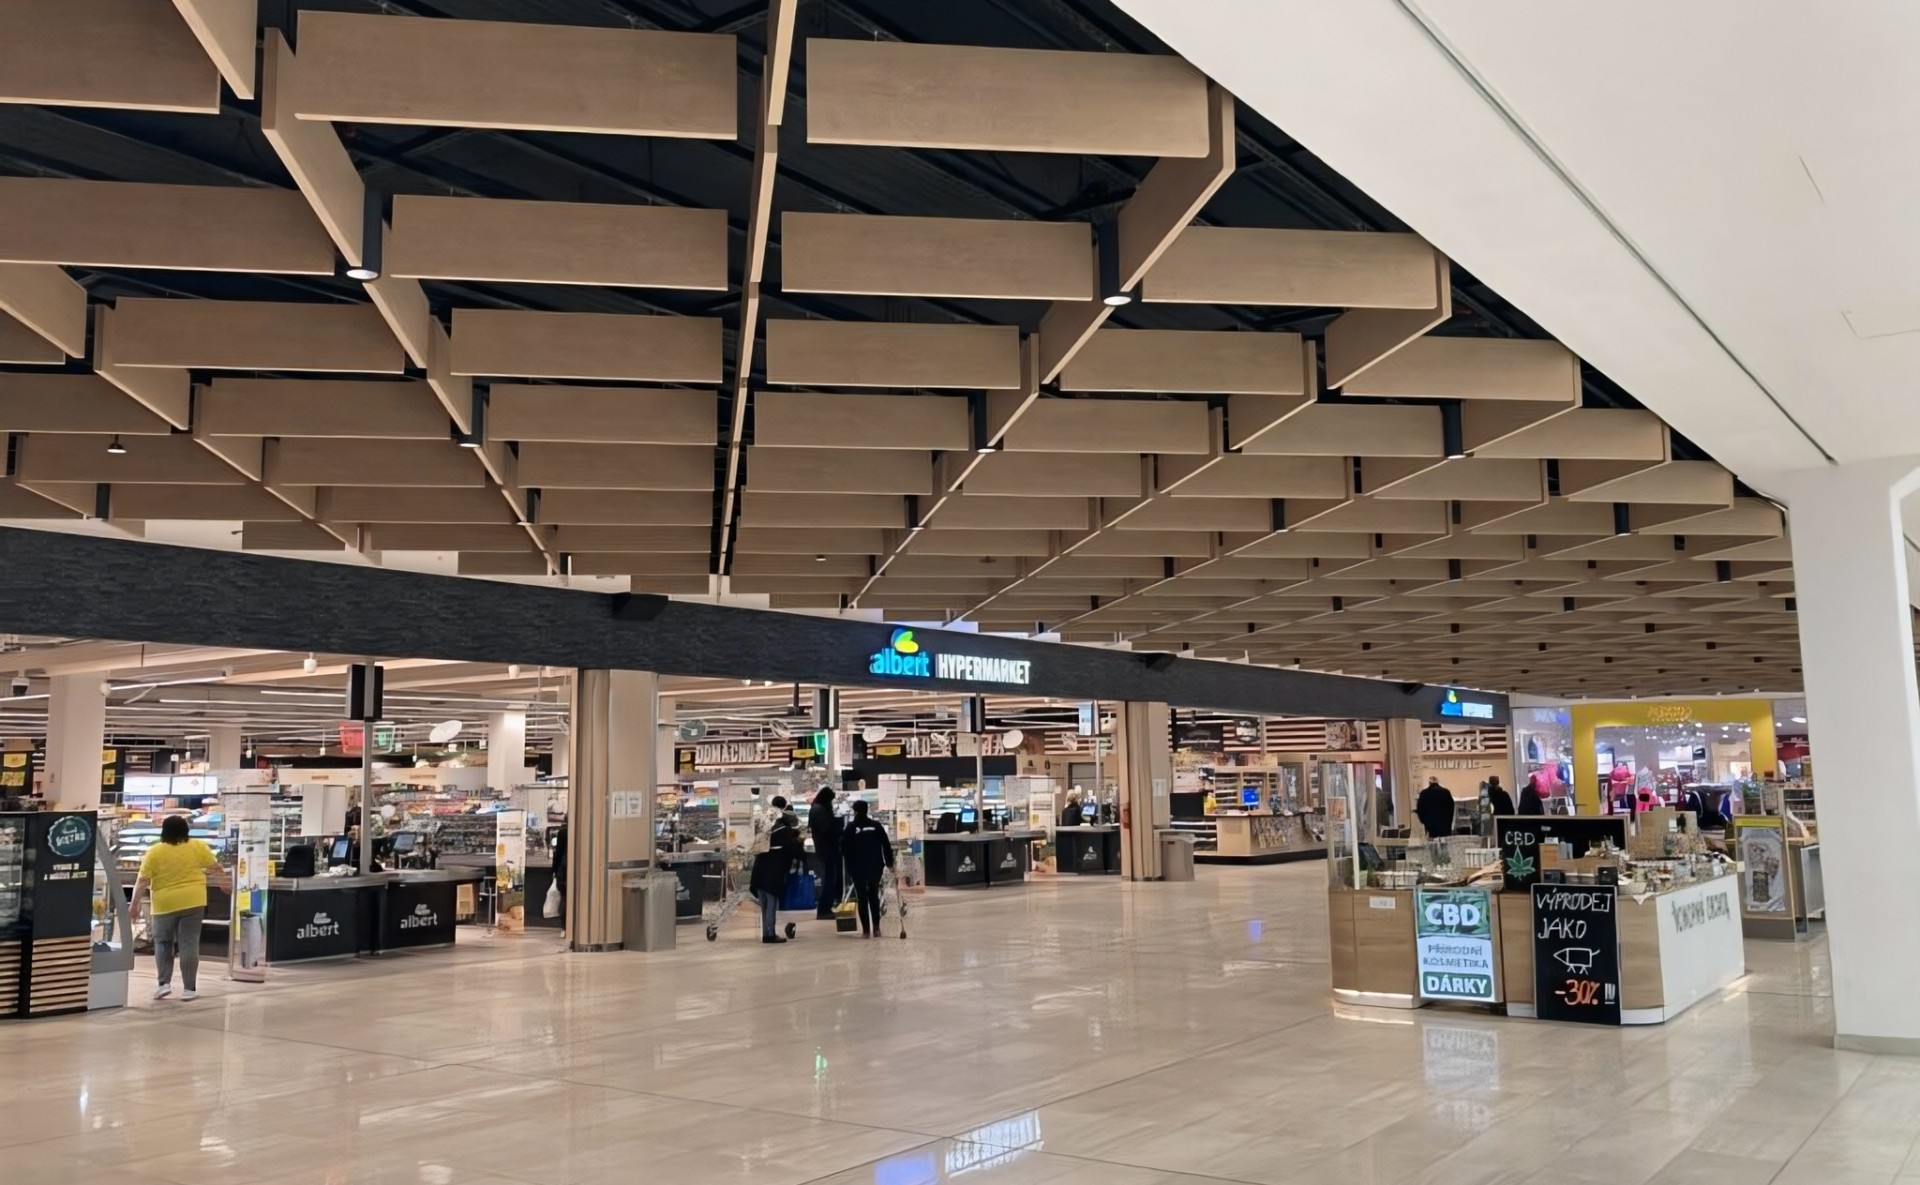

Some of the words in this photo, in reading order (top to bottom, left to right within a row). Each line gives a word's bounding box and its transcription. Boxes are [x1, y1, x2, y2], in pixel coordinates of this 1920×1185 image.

[870, 648, 930, 676] albert
[935, 653, 1031, 684] HYPERMARKET
[1505, 831, 1536, 846] CBD
[1536, 887, 1613, 913] VÝPRODEJ
[400, 912, 438, 929] albert
[1425, 903, 1480, 926] CBD
[296, 921, 340, 939] albert
[1537, 917, 1587, 939] JAKO
[1426, 974, 1487, 994] DÁRKY
[1554, 979, 1600, 1006] -30%
